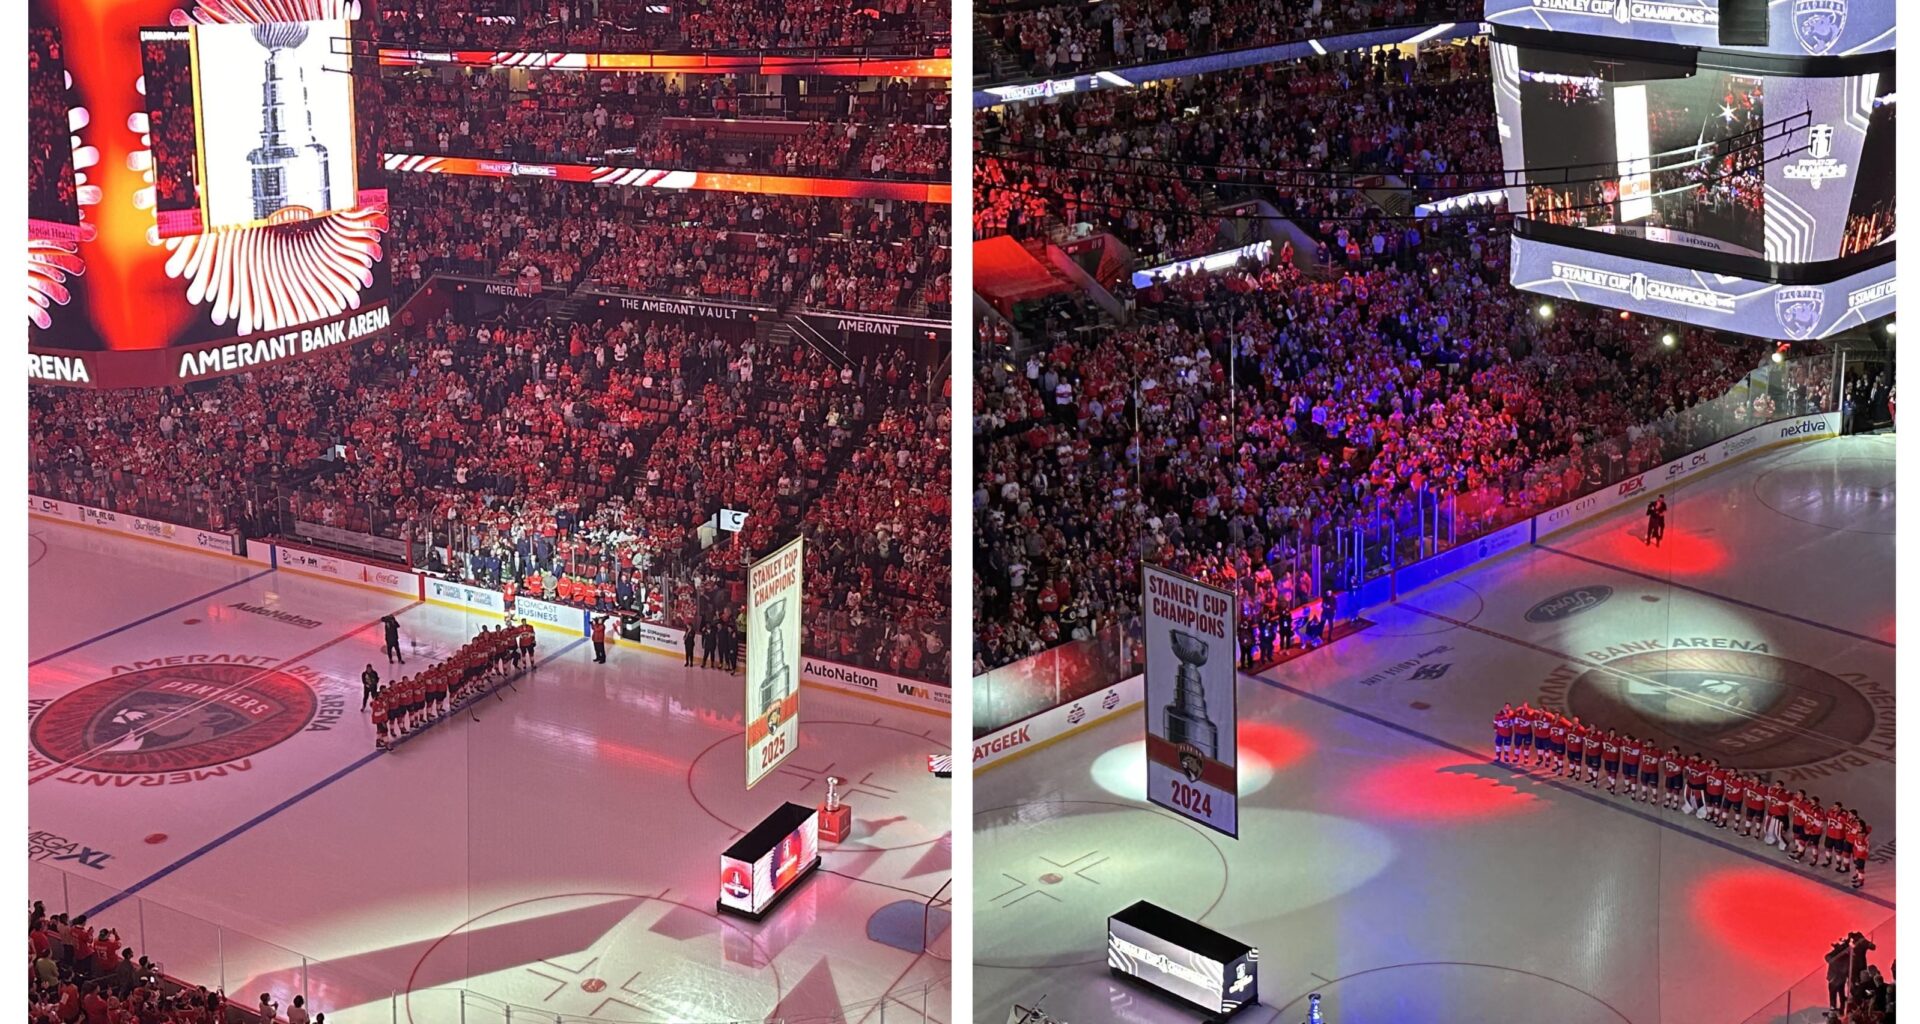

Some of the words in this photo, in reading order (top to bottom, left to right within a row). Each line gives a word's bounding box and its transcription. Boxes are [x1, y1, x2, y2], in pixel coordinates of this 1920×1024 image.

[1591, 1, 1615, 14] CUP
[1631, 4, 1706, 23] CHAMPIONS
[1686, 237, 1721, 250] HONDA
[1562, 267, 1608, 286] STANLEY
[1608, 276, 1631, 289] CUP
[1647, 283, 1718, 308] CHAMPIONS
[1854, 284, 1886, 305] STANLEY
[620, 298, 640, 310] THE
[641, 300, 696, 315] AMERANT
[698, 306, 738, 319] VAULT
[837, 319, 900, 335] AMERANT
[178, 333, 299, 378] AMERANT
[300, 319, 347, 353] BANK
[347, 306, 391, 341] ARENA
[1780, 420, 1826, 438] nextiva
[1618, 475, 1645, 496] DEX
[43, 500, 59, 511] CH
[752, 557, 782, 590] STANLEY
[784, 548, 798, 570] CUP
[754, 568, 796, 608] CHAMPIONS
[1149, 574, 1199, 608] STANLEY
[1203, 594, 1228, 618] CUP
[227, 601, 323, 629] AutoNation
[517, 599, 557, 613] COMCAST
[517, 607, 558, 622] BUSINESS
[1540, 590, 1597, 616] Ford
[1153, 597, 1225, 639] CHAMPIONS
[1585, 638, 1668, 661] BANK
[1671, 636, 1770, 654] ARENA
[111, 653, 281, 675] AMERANT
[803, 661, 879, 690] AutoNation
[159, 681, 270, 715] PANTHERS
[897, 683, 930, 700] WM
[305, 694, 345, 731] ARENA
[1719, 696, 1819, 748] PANTHERS
[762, 732, 785, 769] 2025
[55, 758, 252, 787] AMERANT
[1779, 754, 1870, 782] BANK
[1171, 779, 1213, 818] 2024
[53, 846, 111, 870] XL
